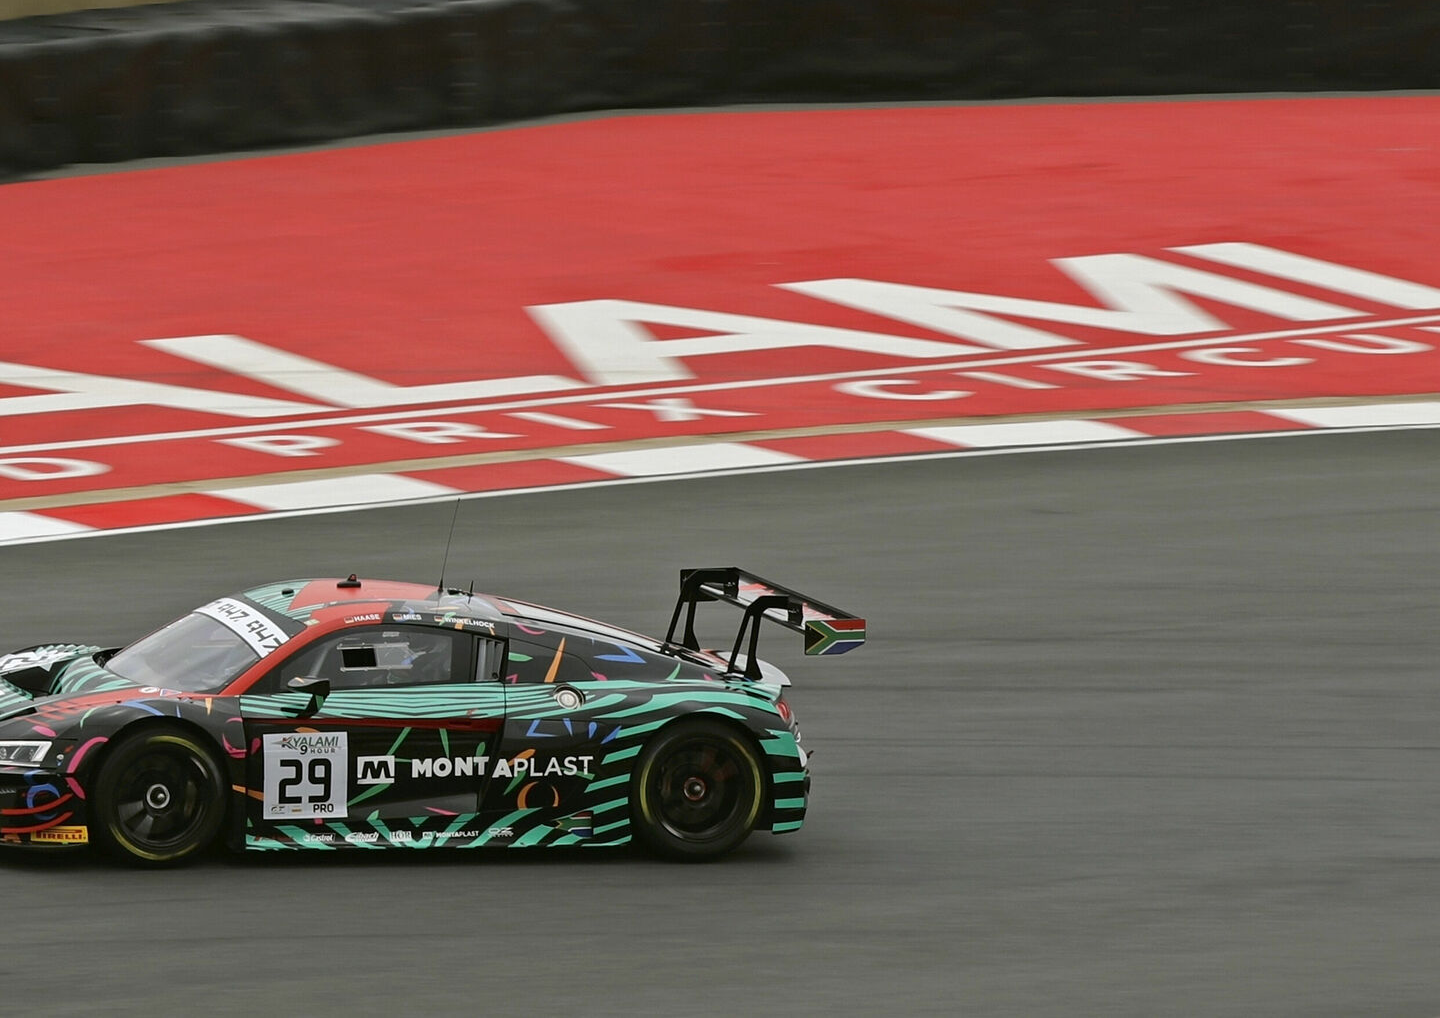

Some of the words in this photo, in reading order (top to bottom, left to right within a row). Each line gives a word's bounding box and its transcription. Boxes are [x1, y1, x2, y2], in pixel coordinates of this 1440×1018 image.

[210, 397, 765, 457] PRIX
[835, 325, 1440, 401] CIRCU
[354, 614, 381, 622] HAASE
[445, 617, 495, 629] WINKELHOCK
[281, 736, 339, 750] KYALAMI
[300, 745, 308, 755] 9
[279, 758, 332, 804] 29
[313, 804, 335, 813] PRO
[36, 829, 82, 840] PIRELLI
[310, 834, 334, 842] Castrol
